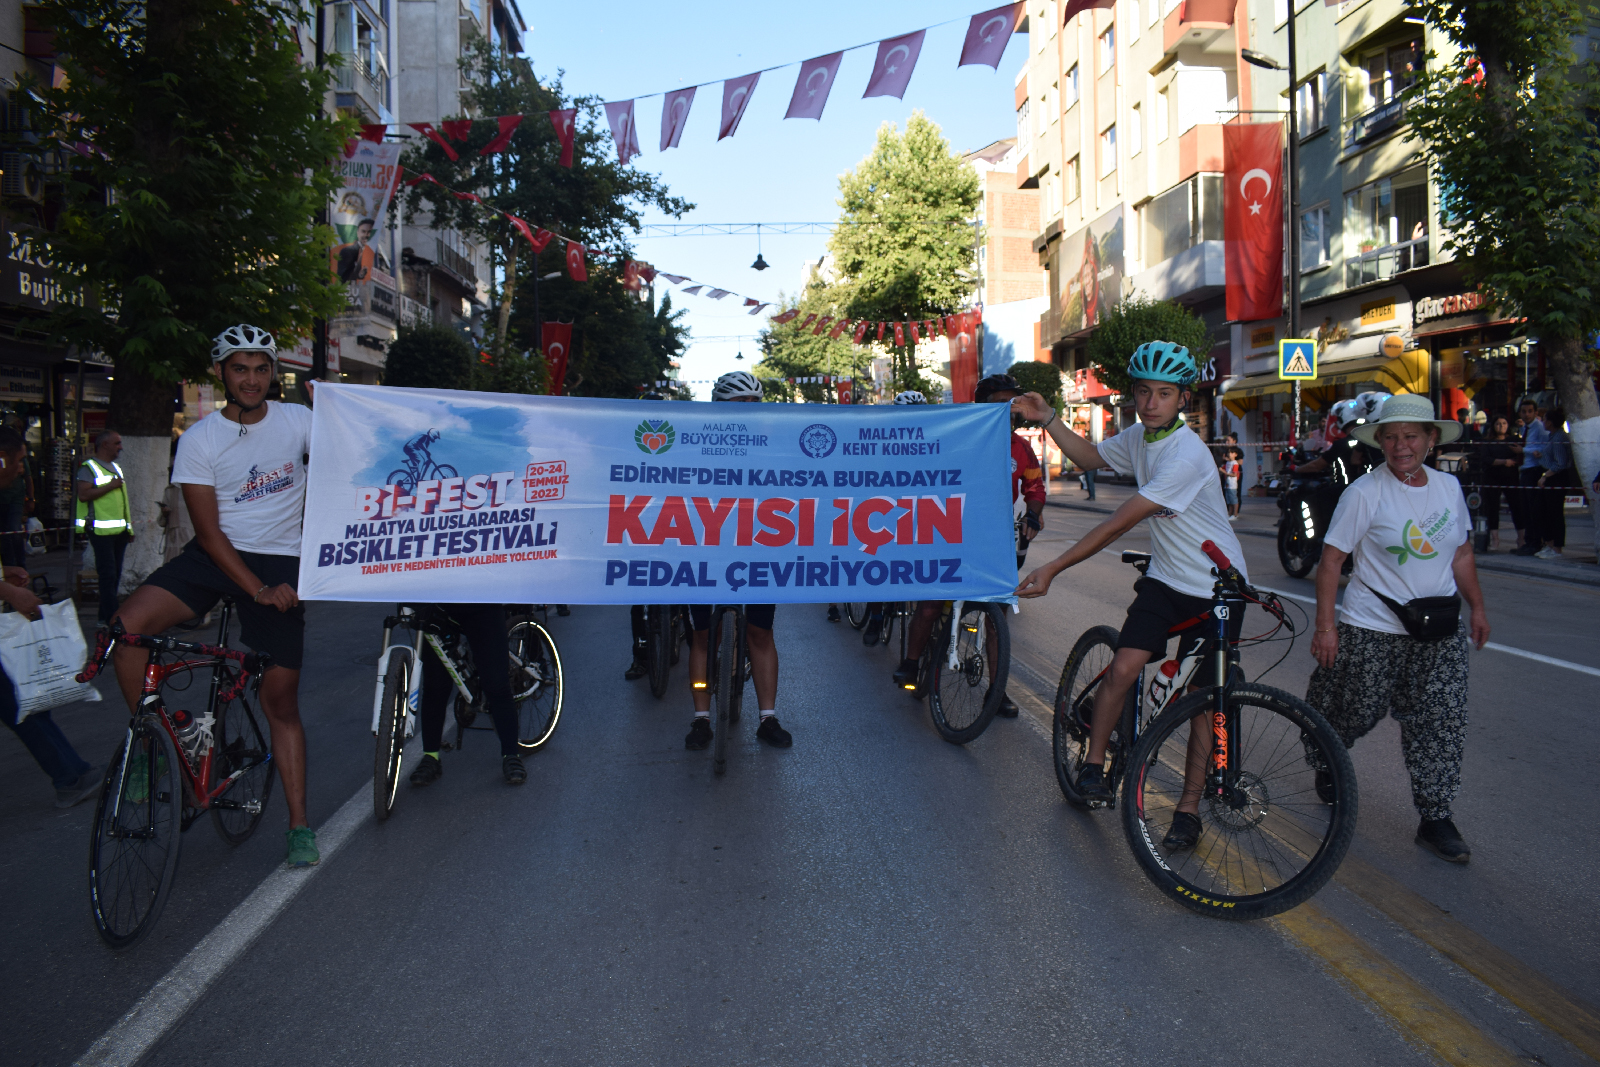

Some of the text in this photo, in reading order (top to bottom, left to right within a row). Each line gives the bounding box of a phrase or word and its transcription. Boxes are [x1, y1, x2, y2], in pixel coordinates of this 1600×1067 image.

[703, 423, 747, 432] MALATYA
[858, 427, 924, 441] MALATYA
[701, 447, 747, 456] BELEDİYESİ
[843, 439, 941, 456] KENT KONSEYİ
[530, 464, 563, 477] 20-24
[833, 469, 962, 487] BURADAYIZ
[522, 474, 569, 488] TEMMUZ
[530, 487, 559, 499] 2022
[345, 507, 536, 540] MALATYA ULUSLARARASI
[605, 493, 816, 547] KAYISI
[361, 549, 558, 575] TARİH VE MEDENİYETİN KALBİNE YOLCULUK
[605, 555, 963, 592] PEDAL ÇEVİRİYORUZ
[1175, 885, 1236, 909] MAXXIS
